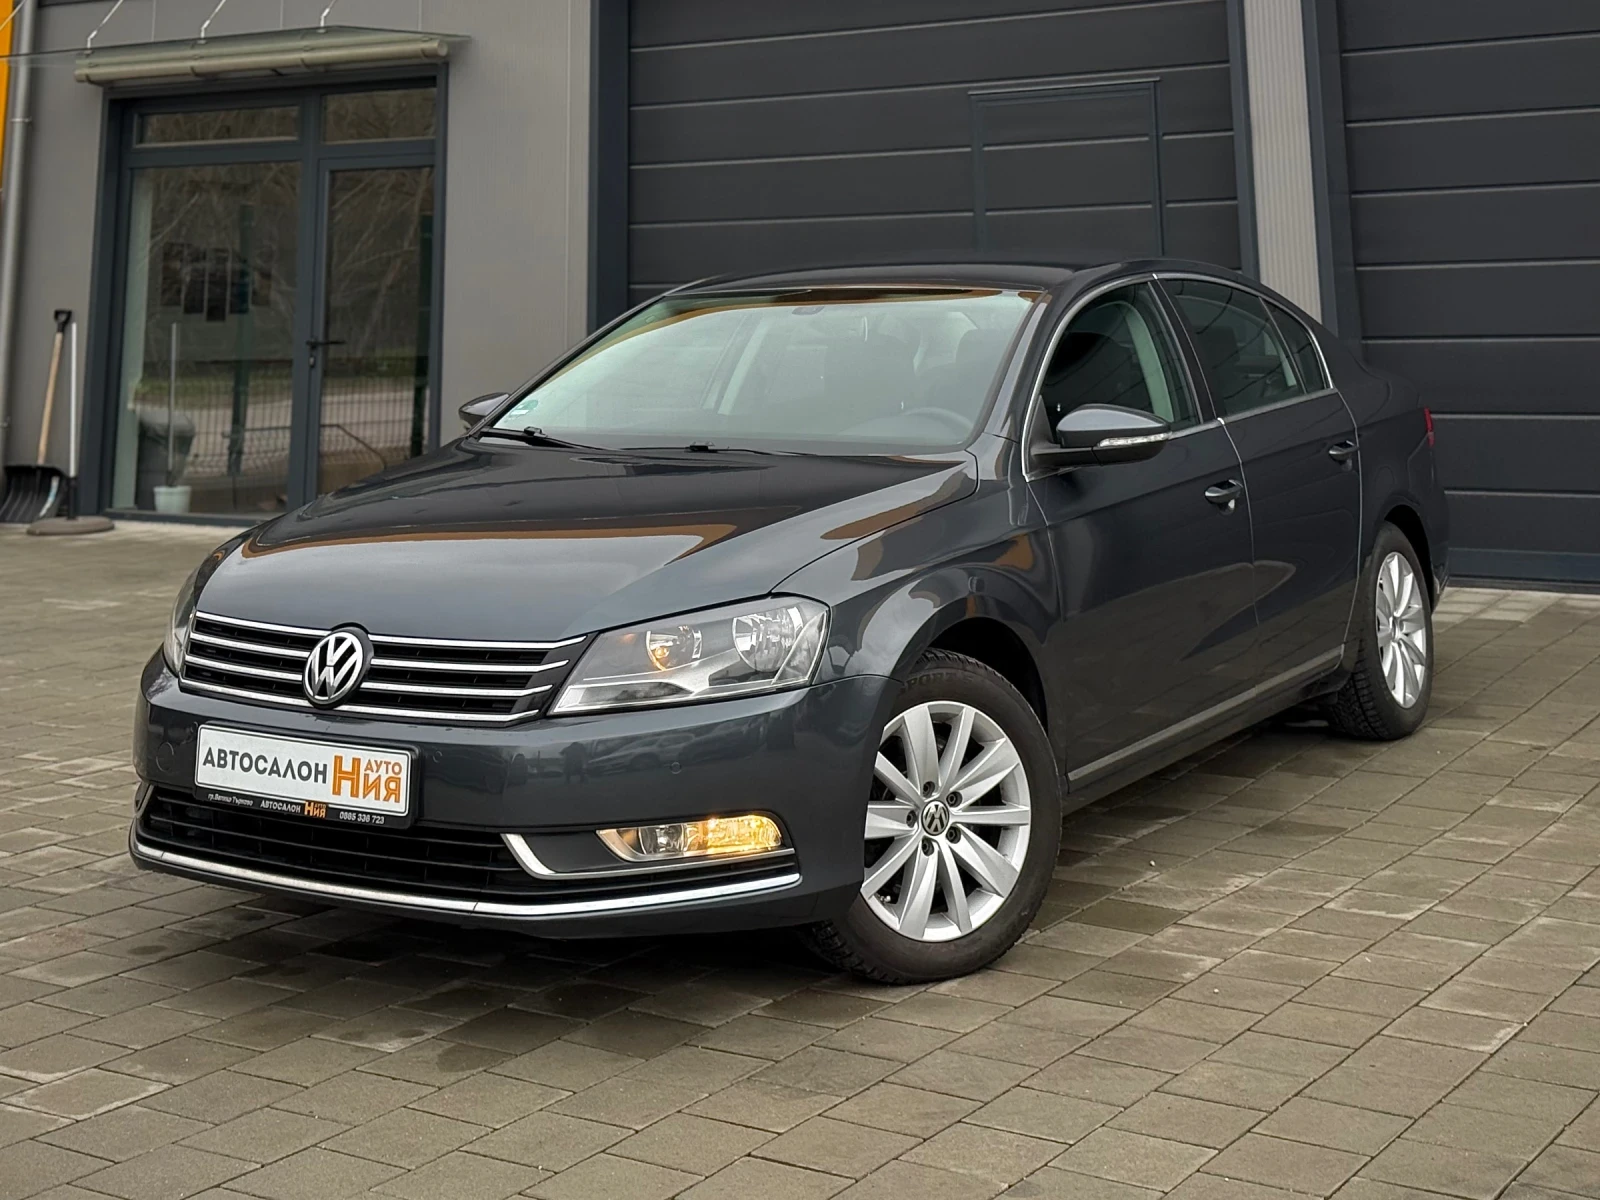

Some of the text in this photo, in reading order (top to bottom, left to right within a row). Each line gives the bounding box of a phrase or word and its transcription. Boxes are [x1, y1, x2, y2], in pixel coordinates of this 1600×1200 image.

[203, 746, 328, 784] АВТОСАЛОН
[364, 758, 402, 776] АУТО
[259, 799, 301, 813] АВТОСАЛОН
[371, 815, 385, 825] 723
